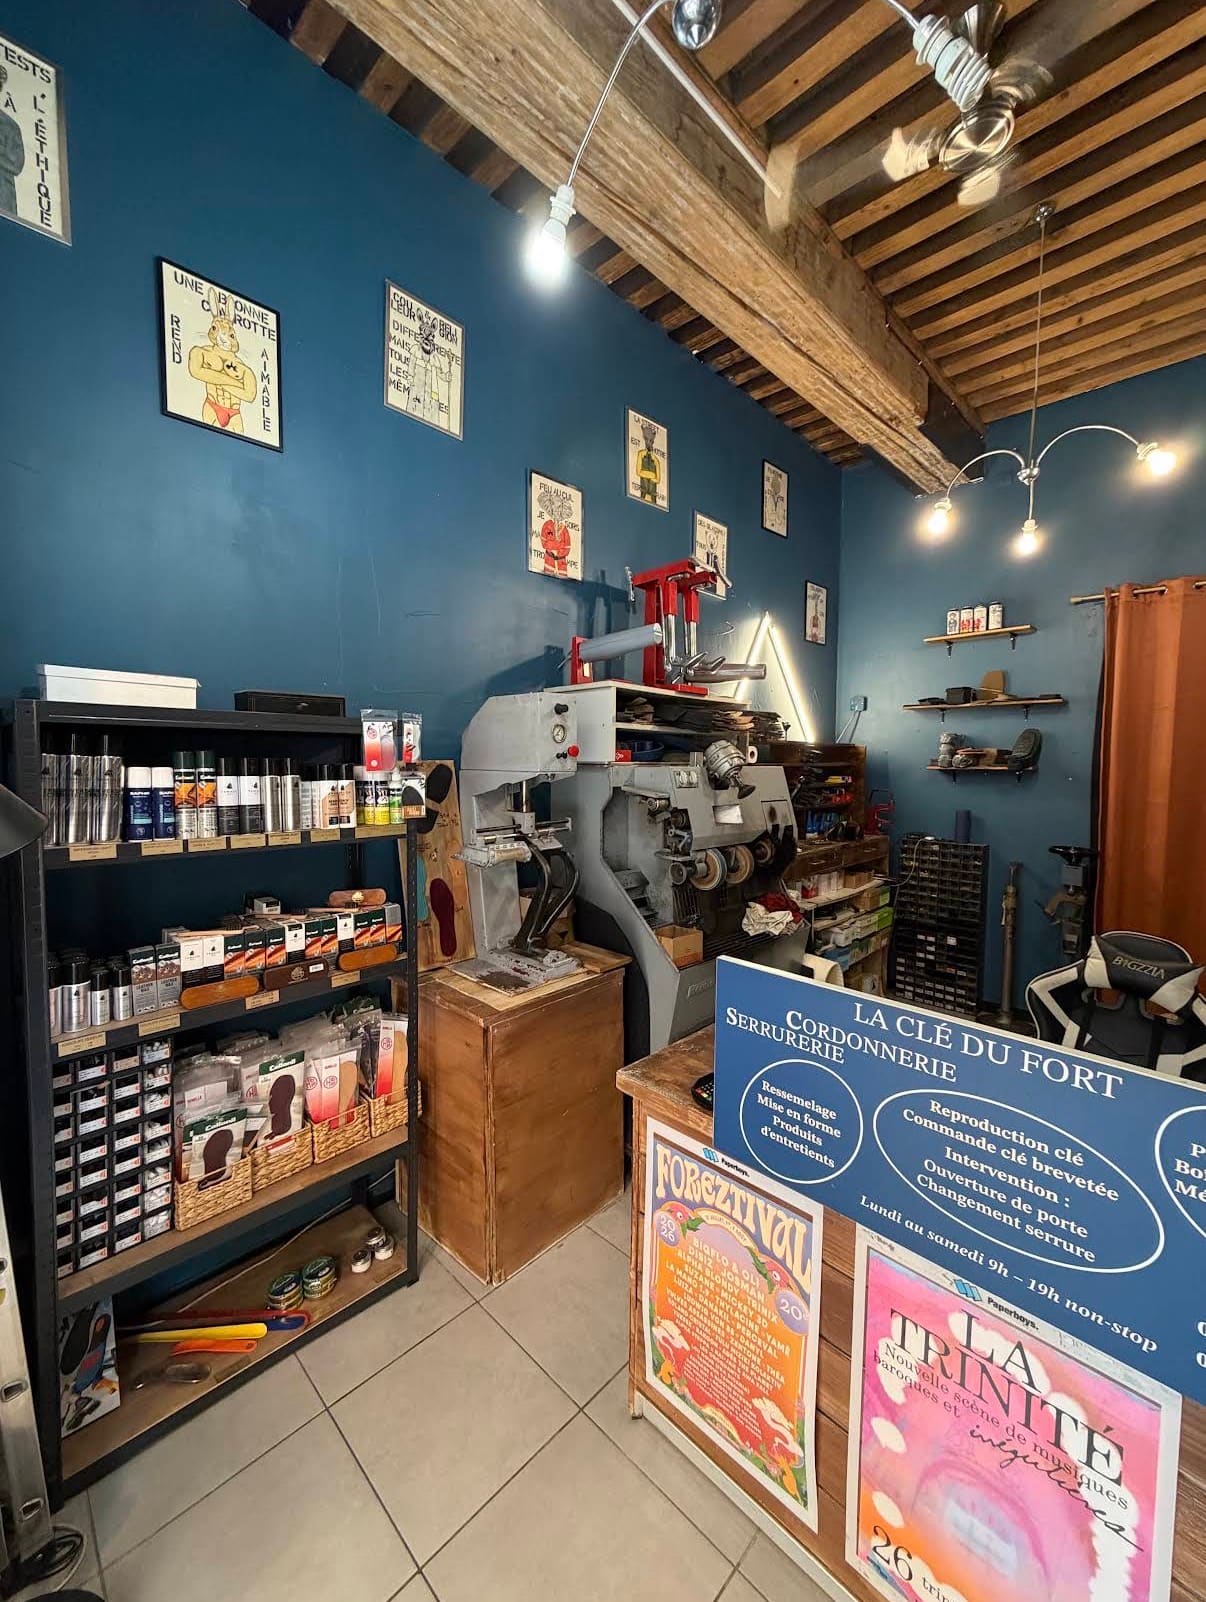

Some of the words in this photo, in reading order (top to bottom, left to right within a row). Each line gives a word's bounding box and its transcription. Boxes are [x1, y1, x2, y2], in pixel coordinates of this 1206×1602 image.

[174, 270, 204, 296] UNE
[218, 291, 270, 326] BONNE
[170, 313, 183, 364] REND
[260, 347, 272, 432] AIMABLE
[390, 363, 409, 381] LES
[726, 1007, 845, 1064] SERRURERIE
[786, 1010, 957, 1083] CORDONNERIE
[853, 1003, 889, 1030] LA
[896, 1015, 952, 1049] CLÉ
[960, 1032, 1012, 1065] DU
[1019, 1049, 1123, 1099] FORT
[757, 1093, 785, 1116] Mise
[787, 1106, 801, 1120] en
[804, 1113, 841, 1138] forme
[762, 1080, 837, 1120] Ressemelage
[772, 1115, 823, 1146] Produits
[761, 1126, 835, 1168] d'entretients
[903, 1108, 997, 1154] Commande
[1000, 1147, 1028, 1166] clé
[1032, 1157, 1119, 1201] brevetée
[930, 1099, 1049, 1154] Reproduction
[1054, 1146, 1085, 1166] clé
[924, 1159, 1007, 1202] Ouverture
[1011, 1198, 1033, 1214] de
[1037, 1208, 1088, 1238] porte
[944, 1146, 1060, 1203] Intervention
[655, 1143, 811, 1295] FOREZTIVAL
[660, 1214, 675, 1232] 20
[661, 1226, 675, 1242] 26
[917, 1173, 1021, 1230] Changement
[1025, 1225, 1096, 1263] serrure
[860, 1195, 902, 1223] Lundi
[905, 1219, 924, 1235] au
[927, 1230, 984, 1265] samedi
[988, 1258, 1009, 1278] 9h
[1027, 1278, 1060, 1304] 19h
[1064, 1298, 1158, 1353] non-stop
[987, 1297, 1040, 1330] Paperboys.
[960, 1309, 1042, 1394] LA
[874, 1350, 938, 1404] baroques
[944, 1401, 960, 1418] et
[890, 1308, 1124, 1486] TRINITÉ
[885, 1342, 949, 1395] Nouvelle
[953, 1392, 1000, 1427] scène
[1005, 1424, 1027, 1445] de
[1033, 1442, 1128, 1511] musiques
[872, 1525, 913, 1581] 26
